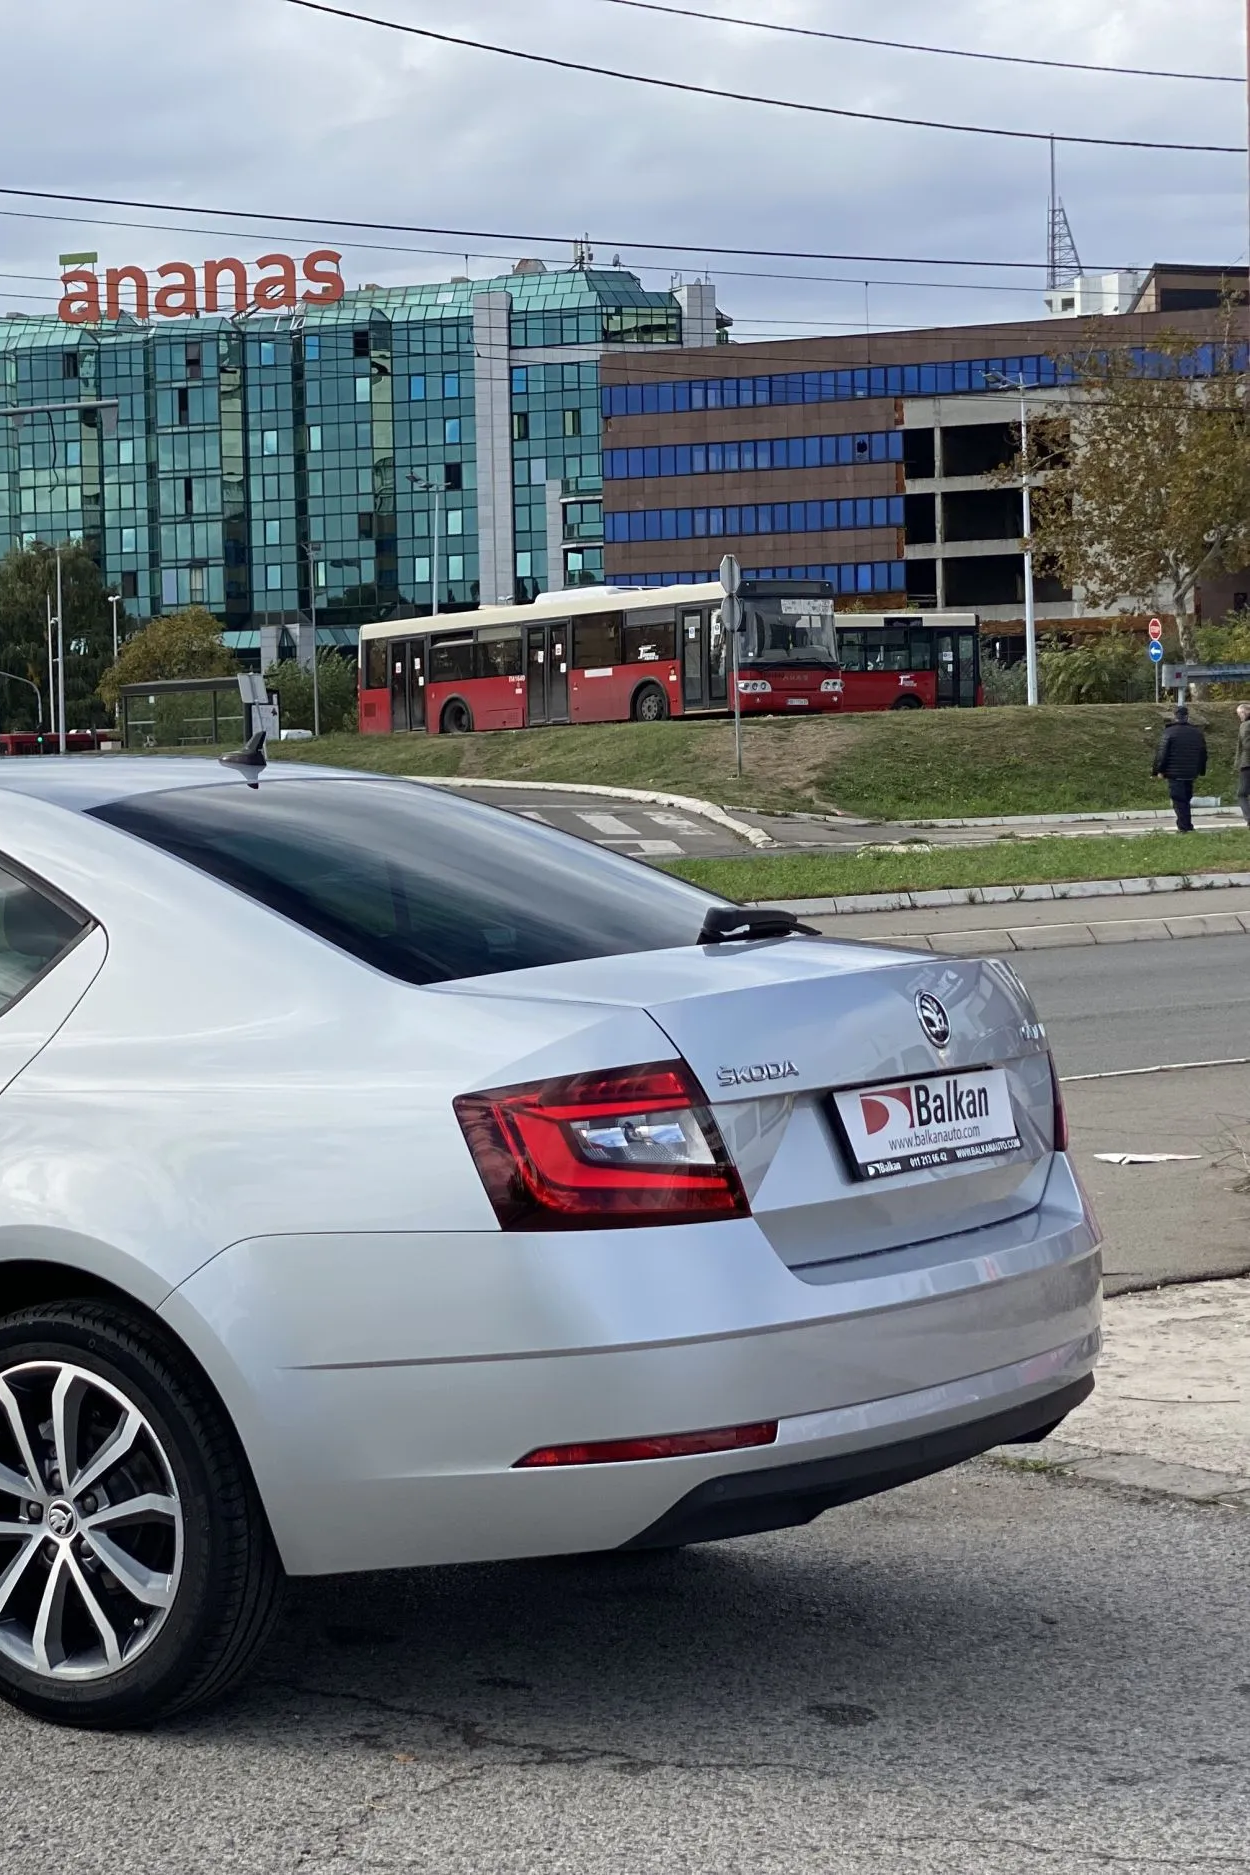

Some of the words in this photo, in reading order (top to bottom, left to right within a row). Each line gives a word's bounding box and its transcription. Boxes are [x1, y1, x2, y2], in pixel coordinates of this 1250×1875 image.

[58, 249, 346, 324] ananas
[716, 1059, 800, 1087] ŠKODA
[914, 1079, 990, 1127] Balkan
[888, 1124, 981, 1151] www.balkanauto.com
[909, 1156, 921, 1168] 011
[920, 1153, 933, 1166] 213
[939, 1151, 948, 1161] 42
[954, 1138, 1021, 1159] WWW.BALKANAUTO.COM
